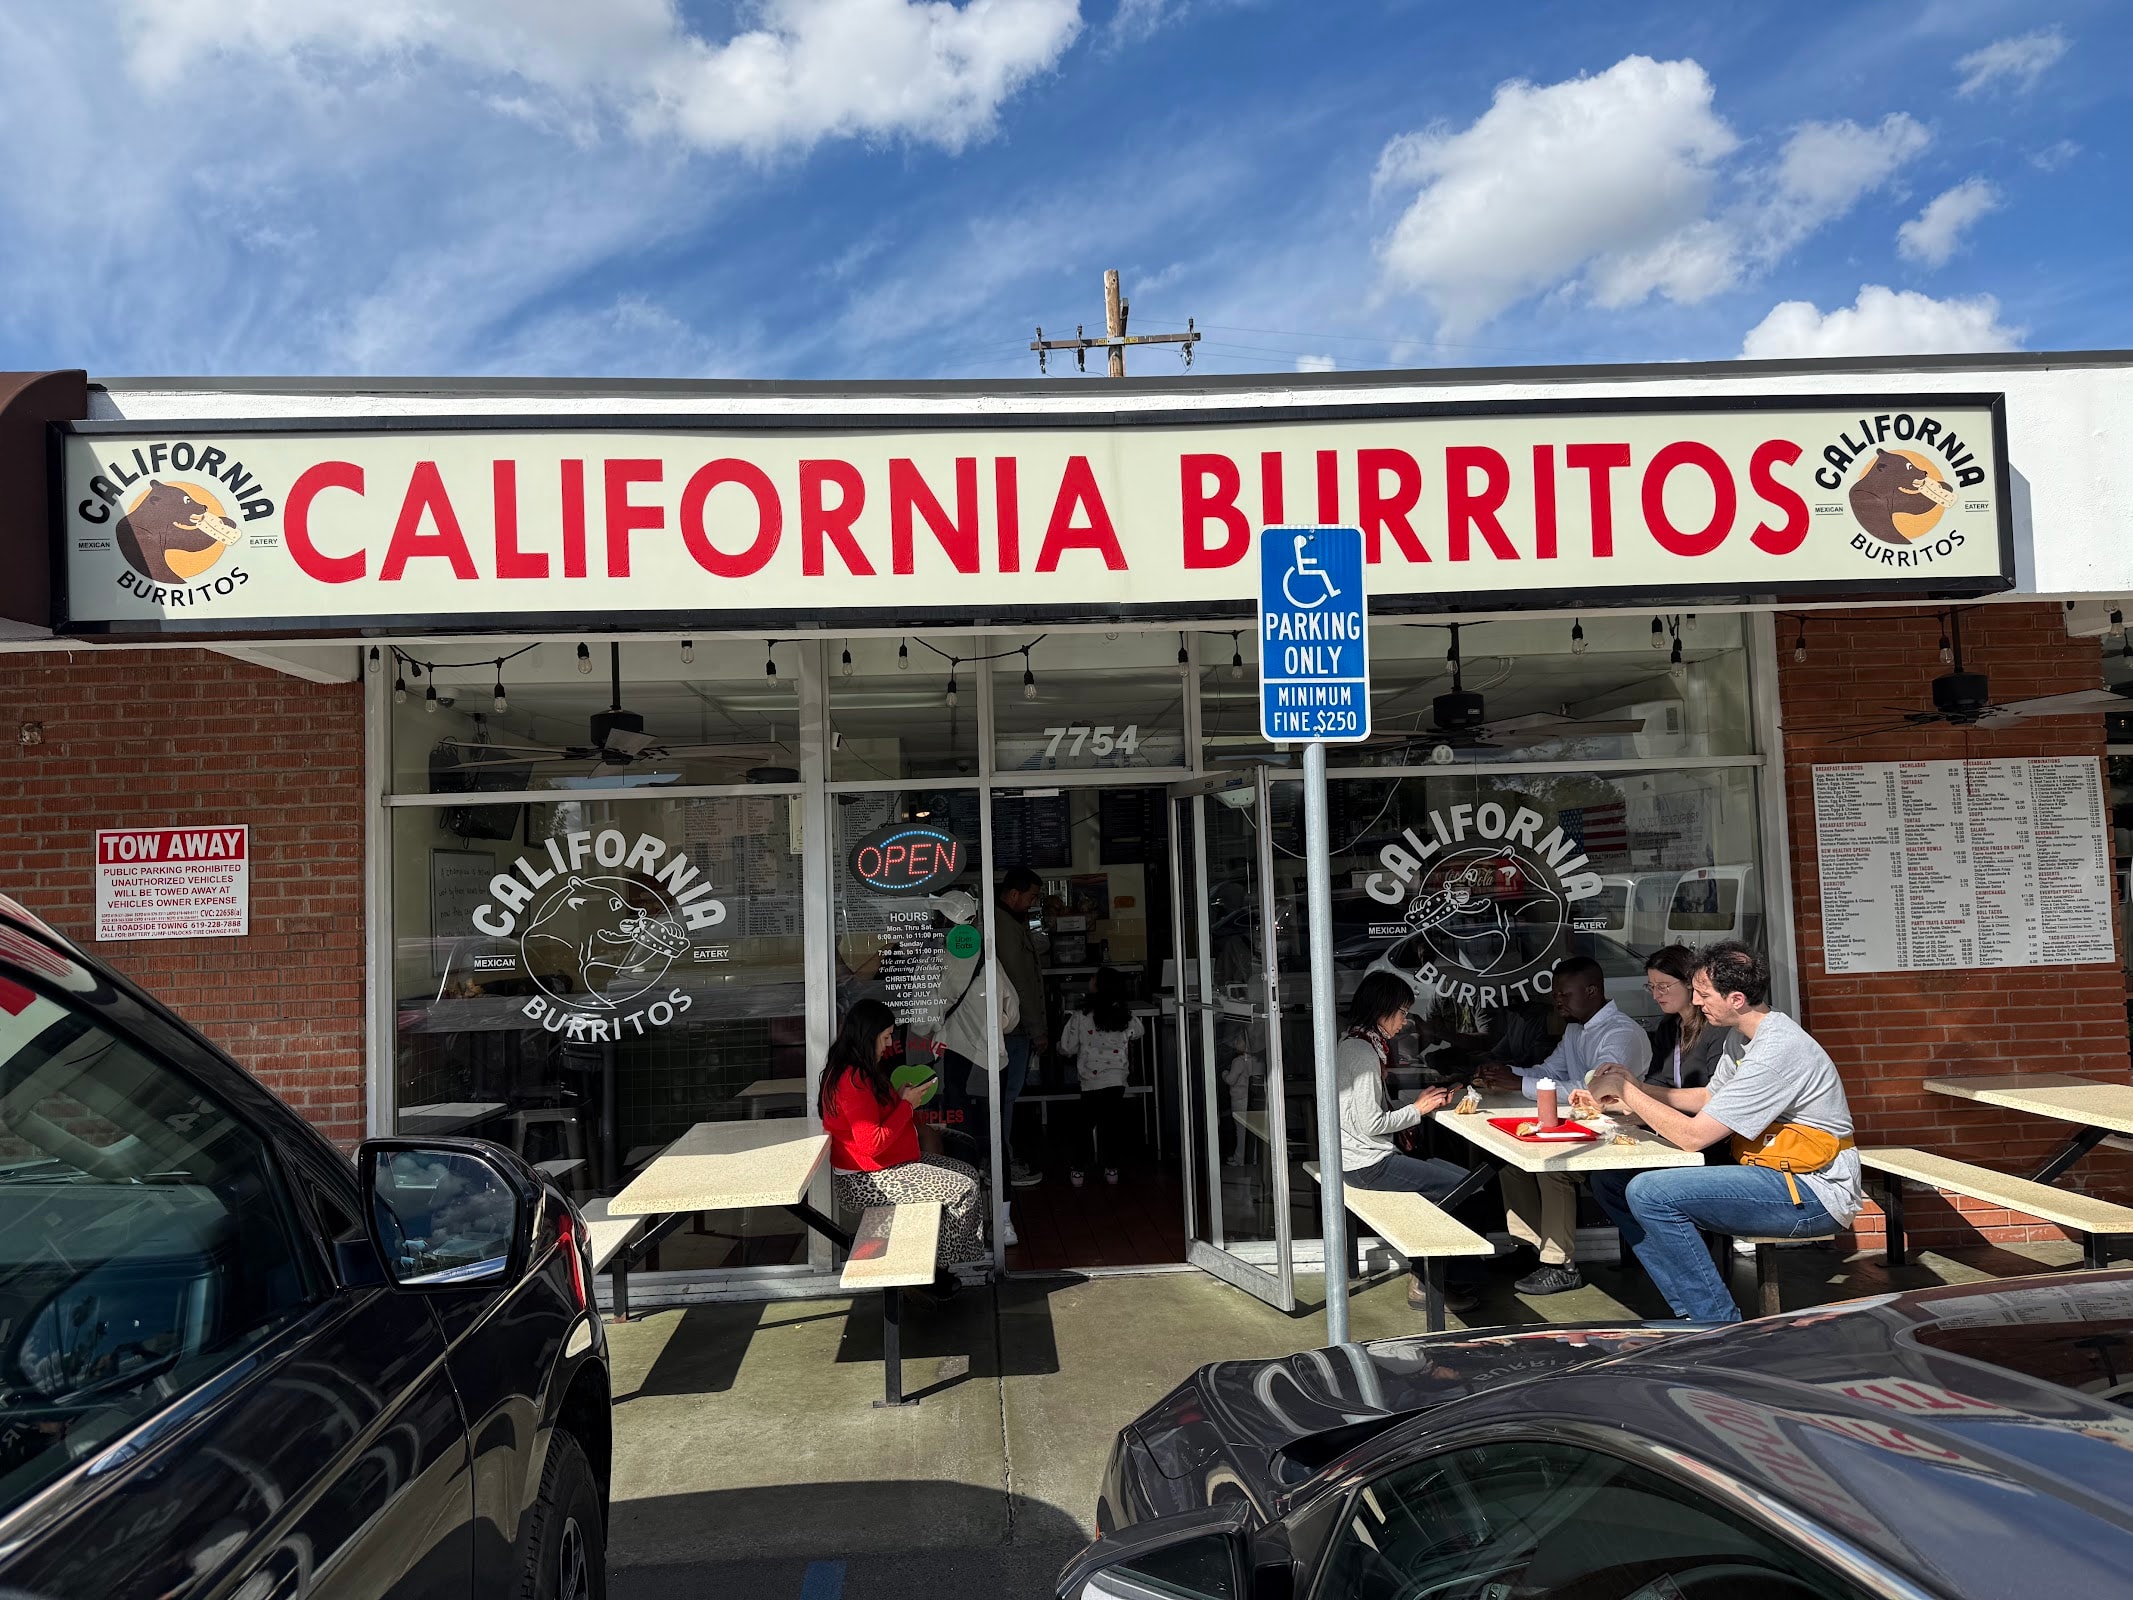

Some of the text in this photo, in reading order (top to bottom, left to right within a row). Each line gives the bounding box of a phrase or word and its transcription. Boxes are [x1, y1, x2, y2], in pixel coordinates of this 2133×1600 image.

[1815, 413, 1985, 488] CALIFORNIA
[78, 442, 274, 524] CALIFORNIA
[284, 439, 1809, 583] CALIFORNIA BURRITOS
[1815, 502, 1989, 513] MEXICAN EATERY
[78, 541, 111, 549] MEXICAN
[1849, 529, 1965, 567] BURRITOS
[116, 566, 249, 607] BURRITOS
[1265, 611, 1361, 641] PARKING
[1284, 645, 1343, 675] ONLY
[1278, 686, 1352, 707] MINIMUM
[1274, 709, 1357, 733] FINE $250
[1043, 724, 1139, 757] 7754
[103, 832, 241, 861] TOW AWAY
[857, 841, 957, 878] OPEN
[1365, 802, 1603, 905] CALIFORNIA
[103, 864, 241, 876] PUBLIC PARKING PROHIBITED
[111, 875, 234, 887] UNAUTHORIZED VEHICLES
[472, 829, 727, 937] CALIFORNIA
[114, 885, 231, 898] WILL BE TOWED AWAY AT
[107, 896, 237, 909] VEHICLES OWNER EXPENSE
[200, 909, 215, 917] CVC:
[890, 911, 929, 922] HOURS
[101, 924, 115, 932] ALL
[117, 923, 156, 931] ROADSIDE
[158, 922, 188, 930] TOWING
[1368, 921, 1607, 935] MEXICAN EATERY
[899, 940, 924, 948] Sunday
[954, 935, 972, 943] Uber
[955, 942, 973, 950] Eats
[474, 949, 729, 968] MEXICAN EATERY
[906, 957, 929, 965] Closed
[879, 965, 915, 974] Following
[885, 974, 926, 982] CHRISTMAS
[885, 981, 942, 991] NEW YEARS DAY
[914, 990, 931, 998] JULY
[521, 987, 693, 1043] BURRITOS
[900, 1007, 928, 1016] EASTER
[895, 1016, 926, 1025] EMORIAL
[906, 1036, 948, 1057] HAVE
